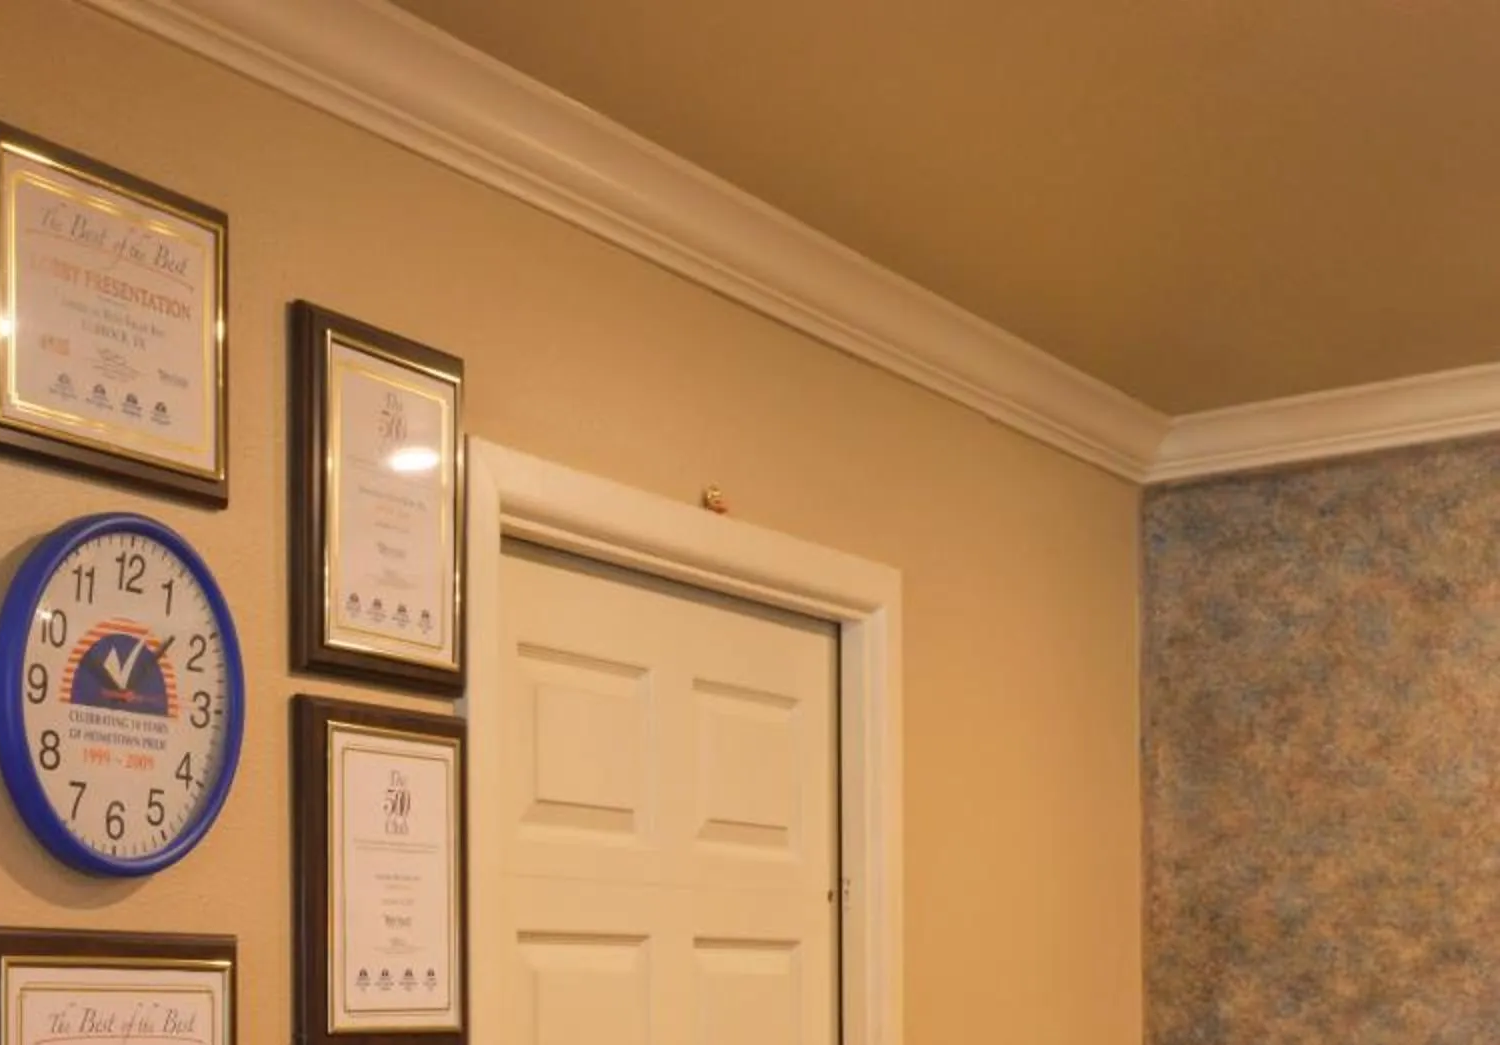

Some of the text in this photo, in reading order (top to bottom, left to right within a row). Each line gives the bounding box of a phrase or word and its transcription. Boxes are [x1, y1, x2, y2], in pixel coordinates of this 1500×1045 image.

[72, 564, 95, 604] 11
[116, 552, 146, 594] 12
[161, 579, 175, 616] 1
[38, 608, 67, 648] 10
[187, 635, 207, 672] 2
[27, 664, 48, 704] 9
[190, 691, 211, 729] 3
[39, 730, 61, 771] 8
[175, 752, 193, 790] 4
[69, 780, 87, 820] 7
[147, 789, 165, 827] 5
[105, 800, 125, 841] 6
[79, 1006, 117, 1034] Best
[163, 1007, 198, 1034] Best
